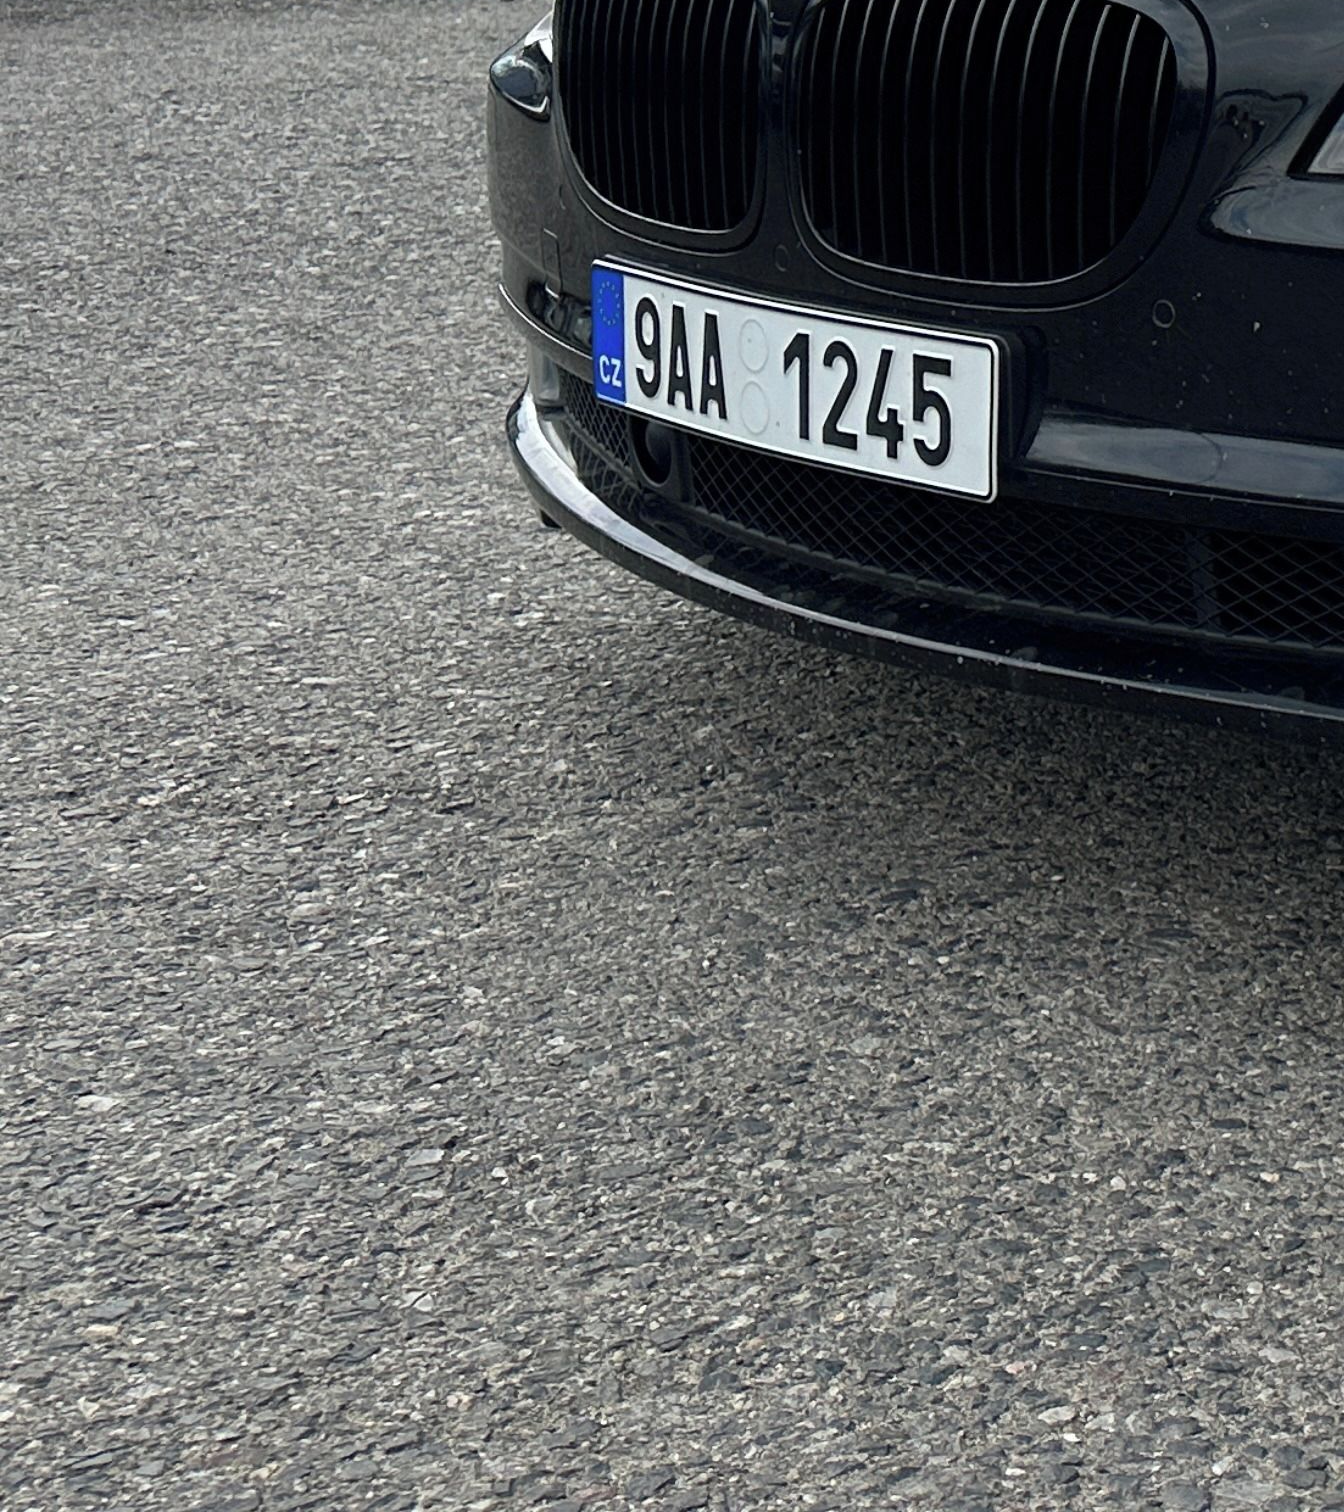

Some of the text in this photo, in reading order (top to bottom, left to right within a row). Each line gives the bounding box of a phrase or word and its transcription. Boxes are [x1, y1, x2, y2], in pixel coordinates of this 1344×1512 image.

[599, 355, 622, 388] CZ
[635, 296, 952, 467] 9AA 1245
